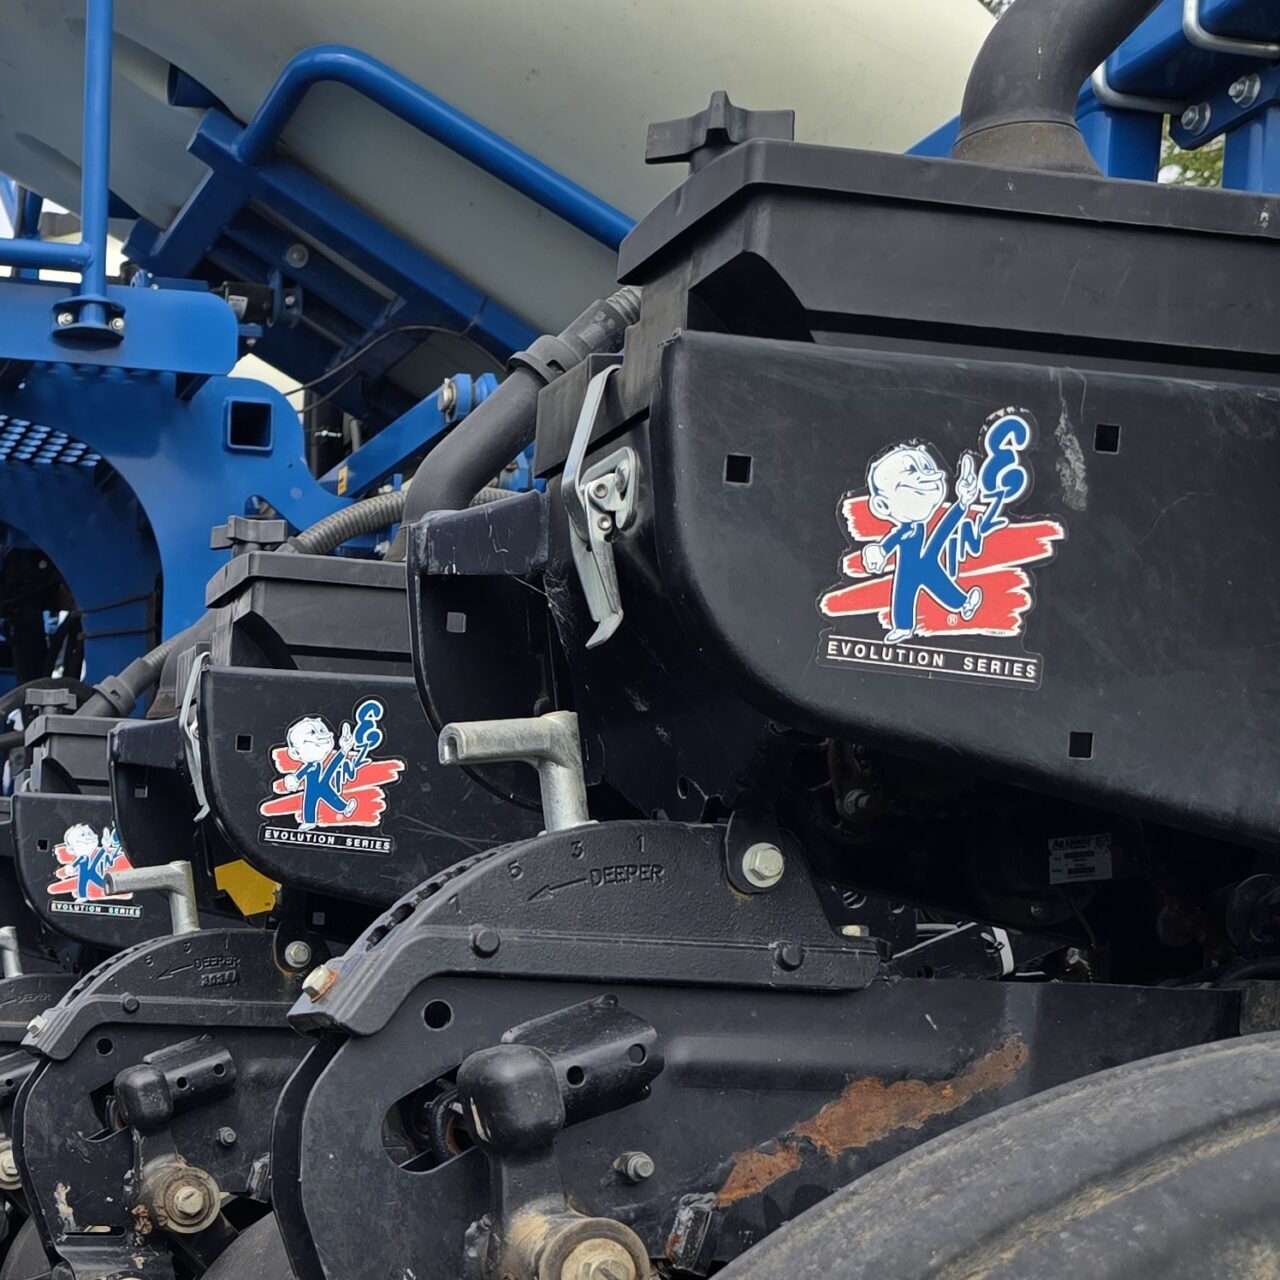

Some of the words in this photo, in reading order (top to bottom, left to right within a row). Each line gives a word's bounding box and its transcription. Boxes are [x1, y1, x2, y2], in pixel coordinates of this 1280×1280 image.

[827, 640, 945, 668] EVOLUTION
[963, 656, 1037, 678] SERIES
[264, 829, 335, 845] EVOLUTION
[345, 837, 391, 850] SERIES
[570, 840, 585, 860] 3
[507, 860, 523, 881] 5
[589, 863, 665, 887] DEEPER
[50, 903, 102, 913] EVOLUTION
[108, 907, 141, 917] SERIES
[195, 955, 241, 971] DEEPER
